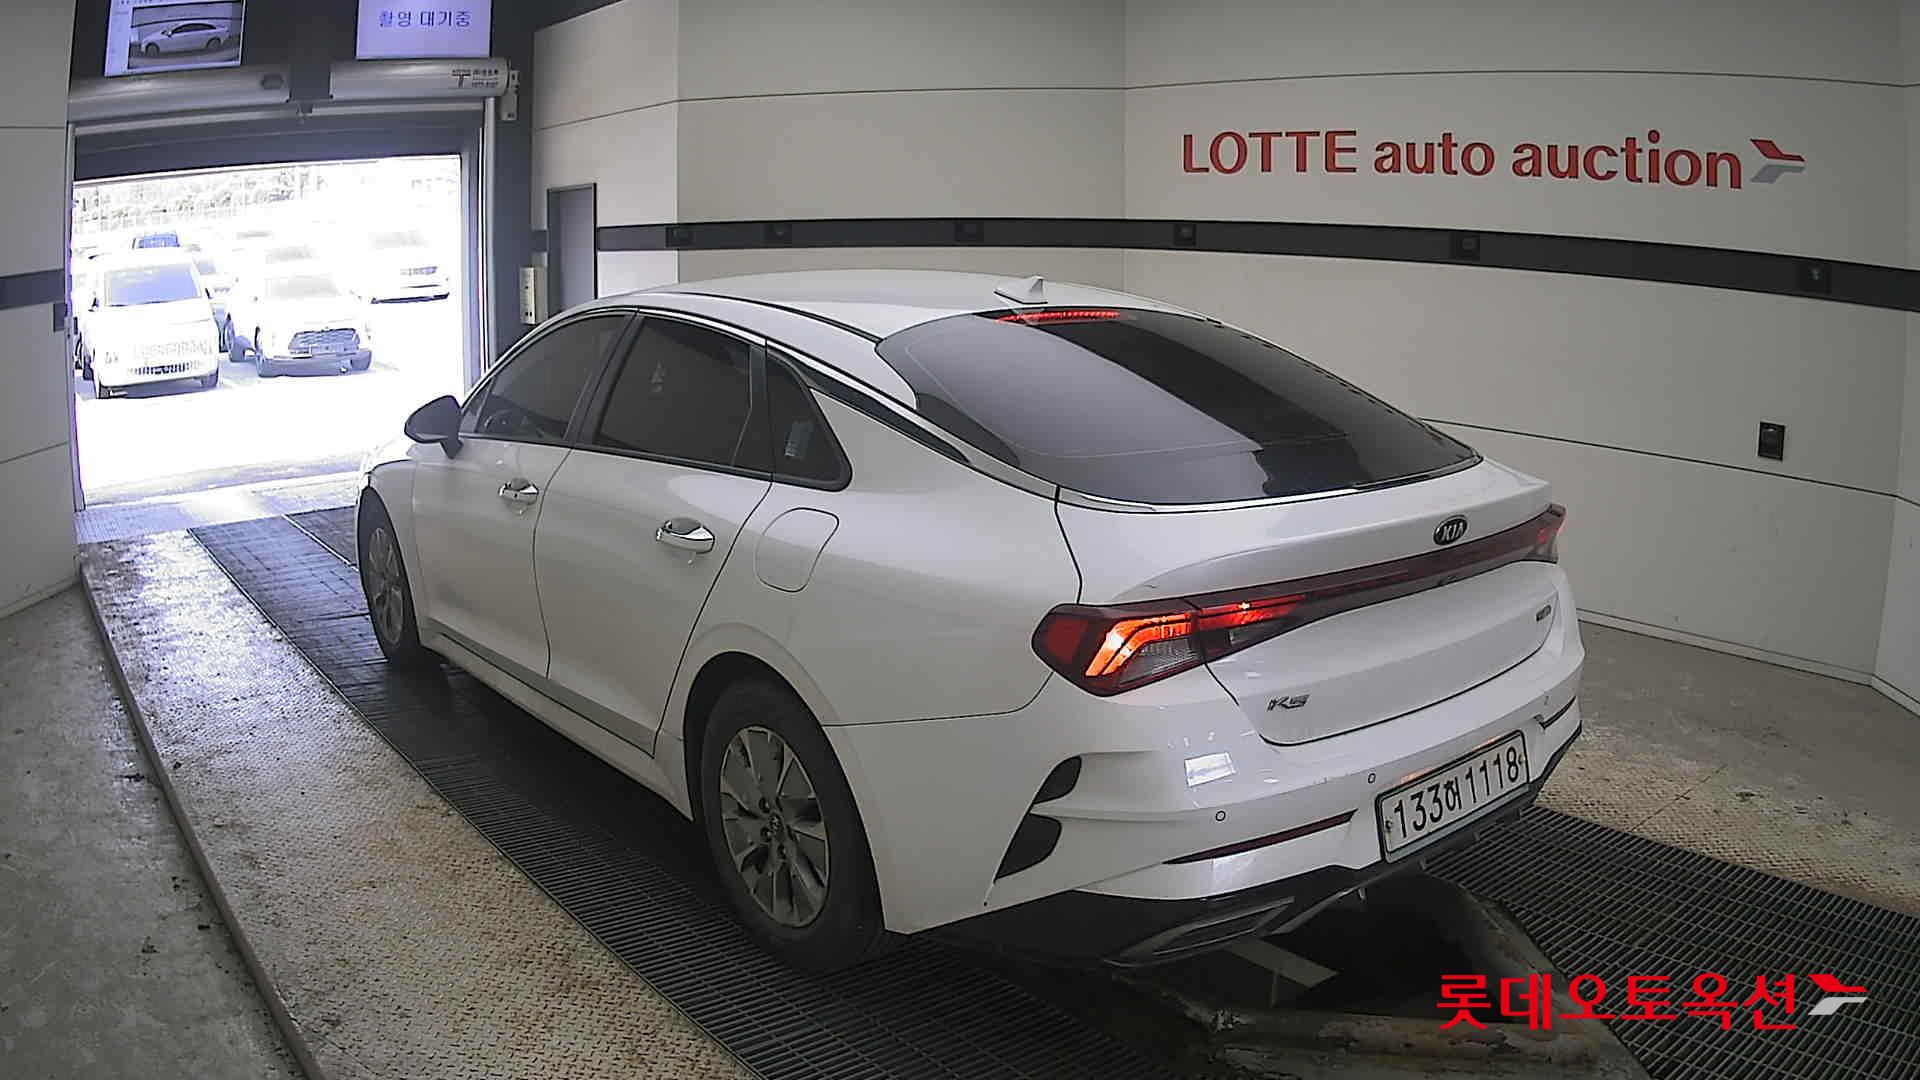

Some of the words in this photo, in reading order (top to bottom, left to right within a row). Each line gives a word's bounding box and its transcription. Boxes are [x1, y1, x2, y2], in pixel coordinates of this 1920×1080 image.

[379, 10, 412, 28] 촬영
[420, 10, 472, 28] 대기중
[1183, 130, 1357, 175] LOTTE
[1374, 131, 1496, 177] auto
[1511, 129, 1743, 190] auction
[1267, 695, 1310, 711] K5
